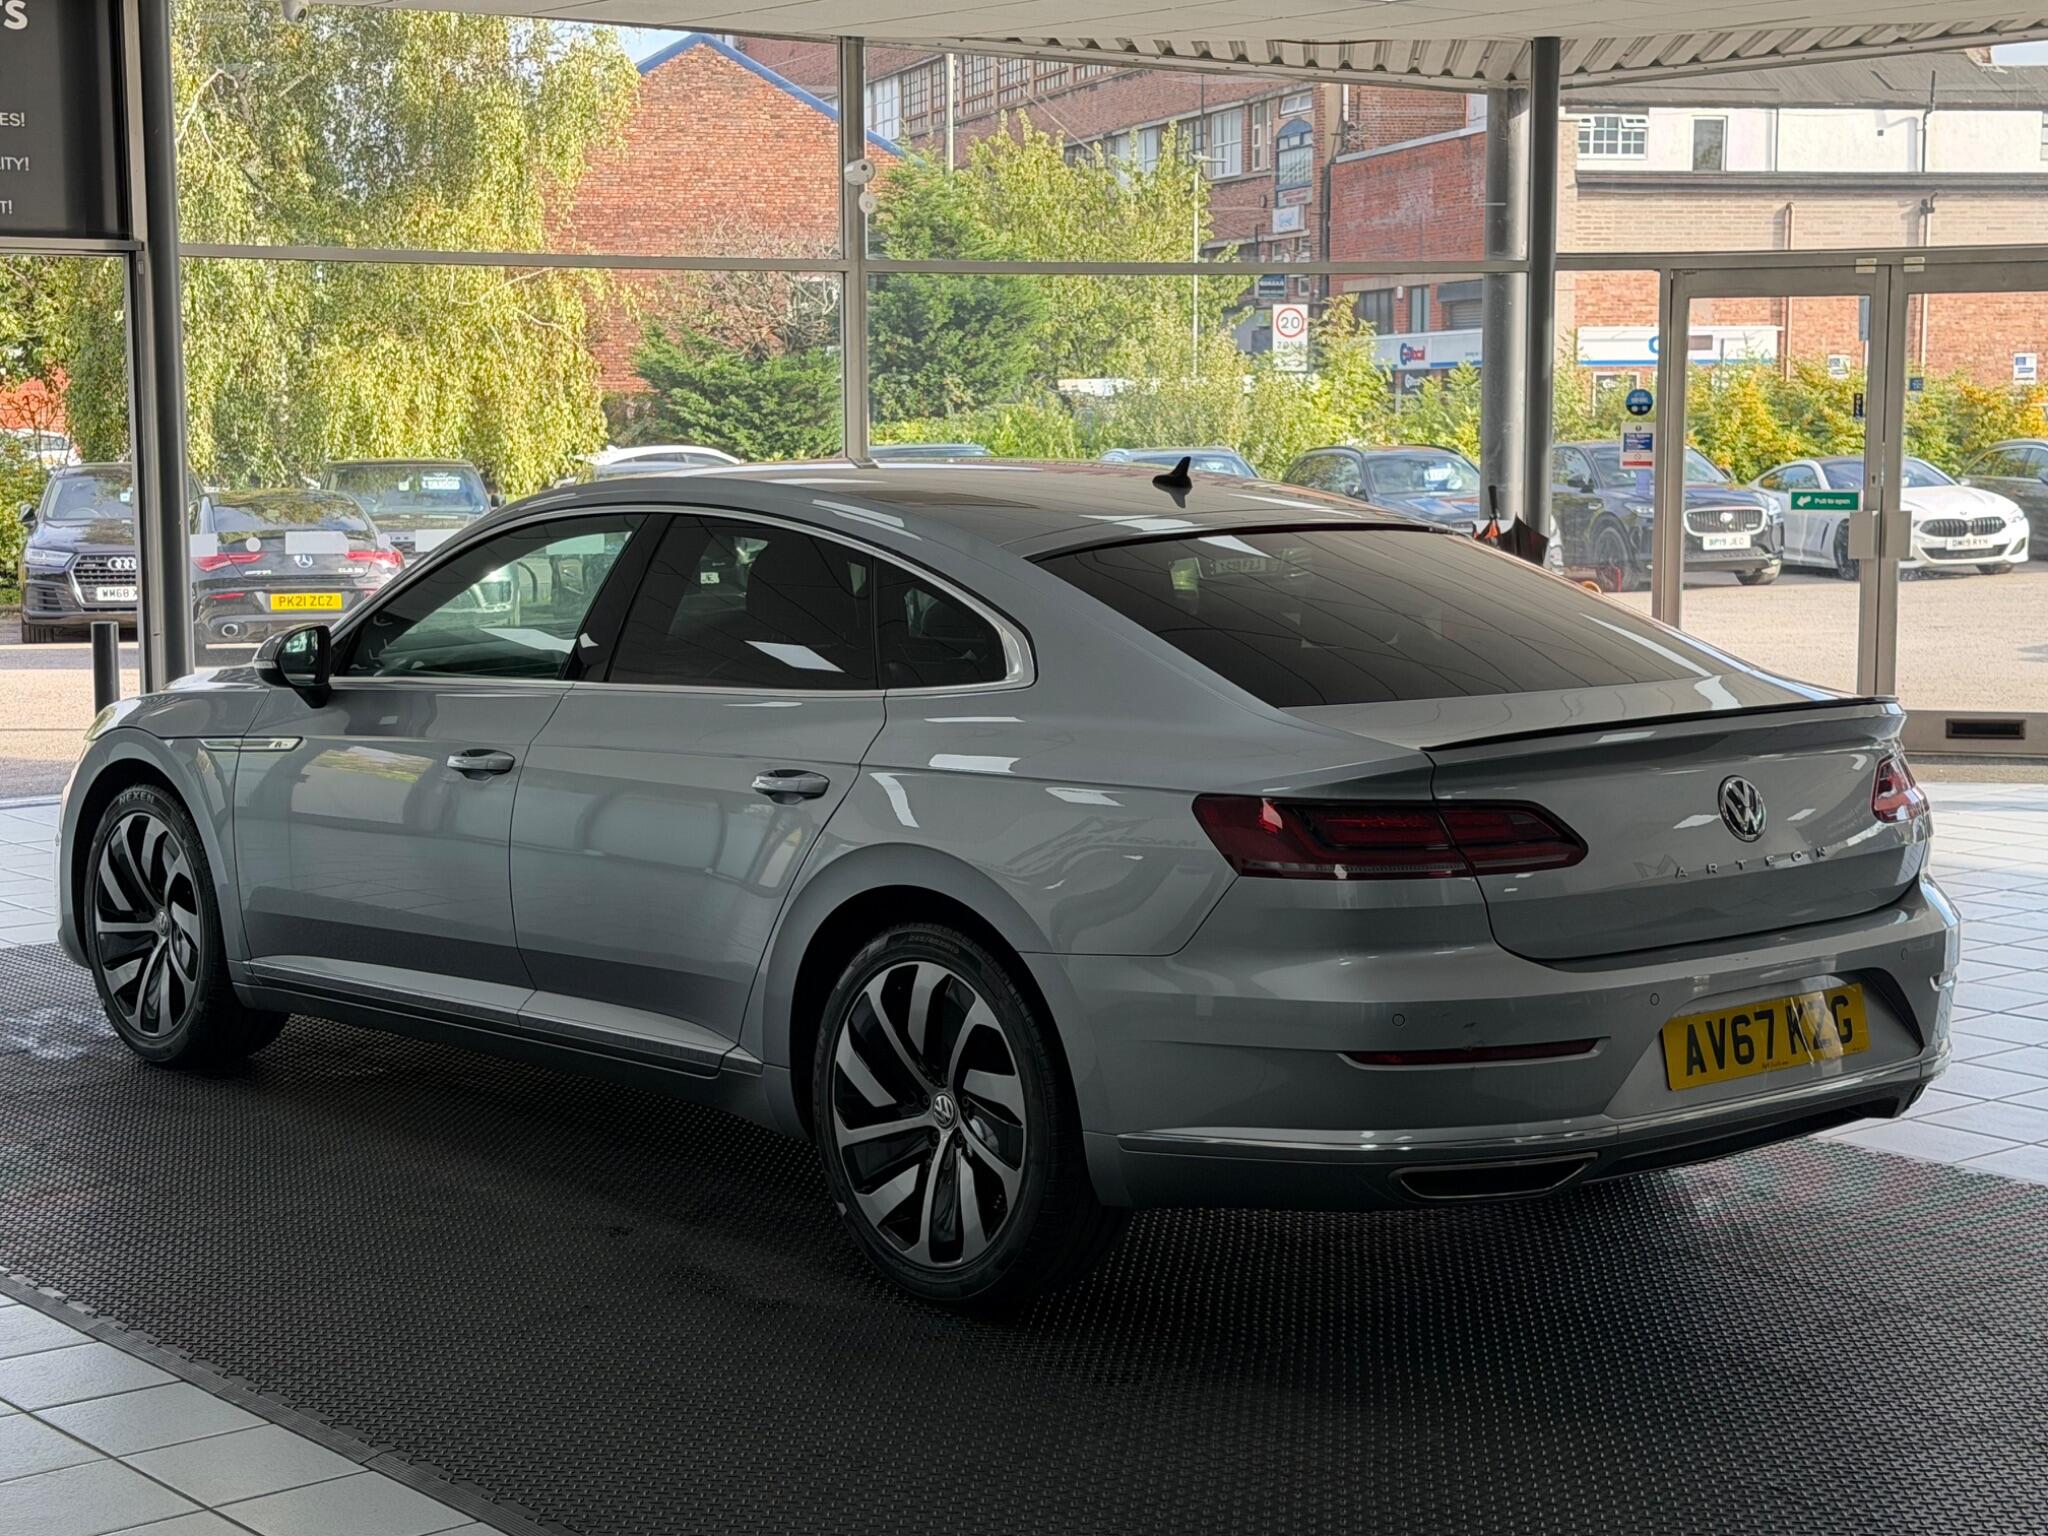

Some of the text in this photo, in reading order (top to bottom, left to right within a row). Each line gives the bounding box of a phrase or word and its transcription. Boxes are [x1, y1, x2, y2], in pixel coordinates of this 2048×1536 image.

[0, 0, 28, 30] S
[1281, 317, 1300, 329] 20
[279, 595, 333, 607] PK21 ZCZ
[119, 791, 154, 806] NEXEN
[1675, 847, 1827, 879] ARTEON
[1686, 994, 1853, 1076] AV67 KZG
